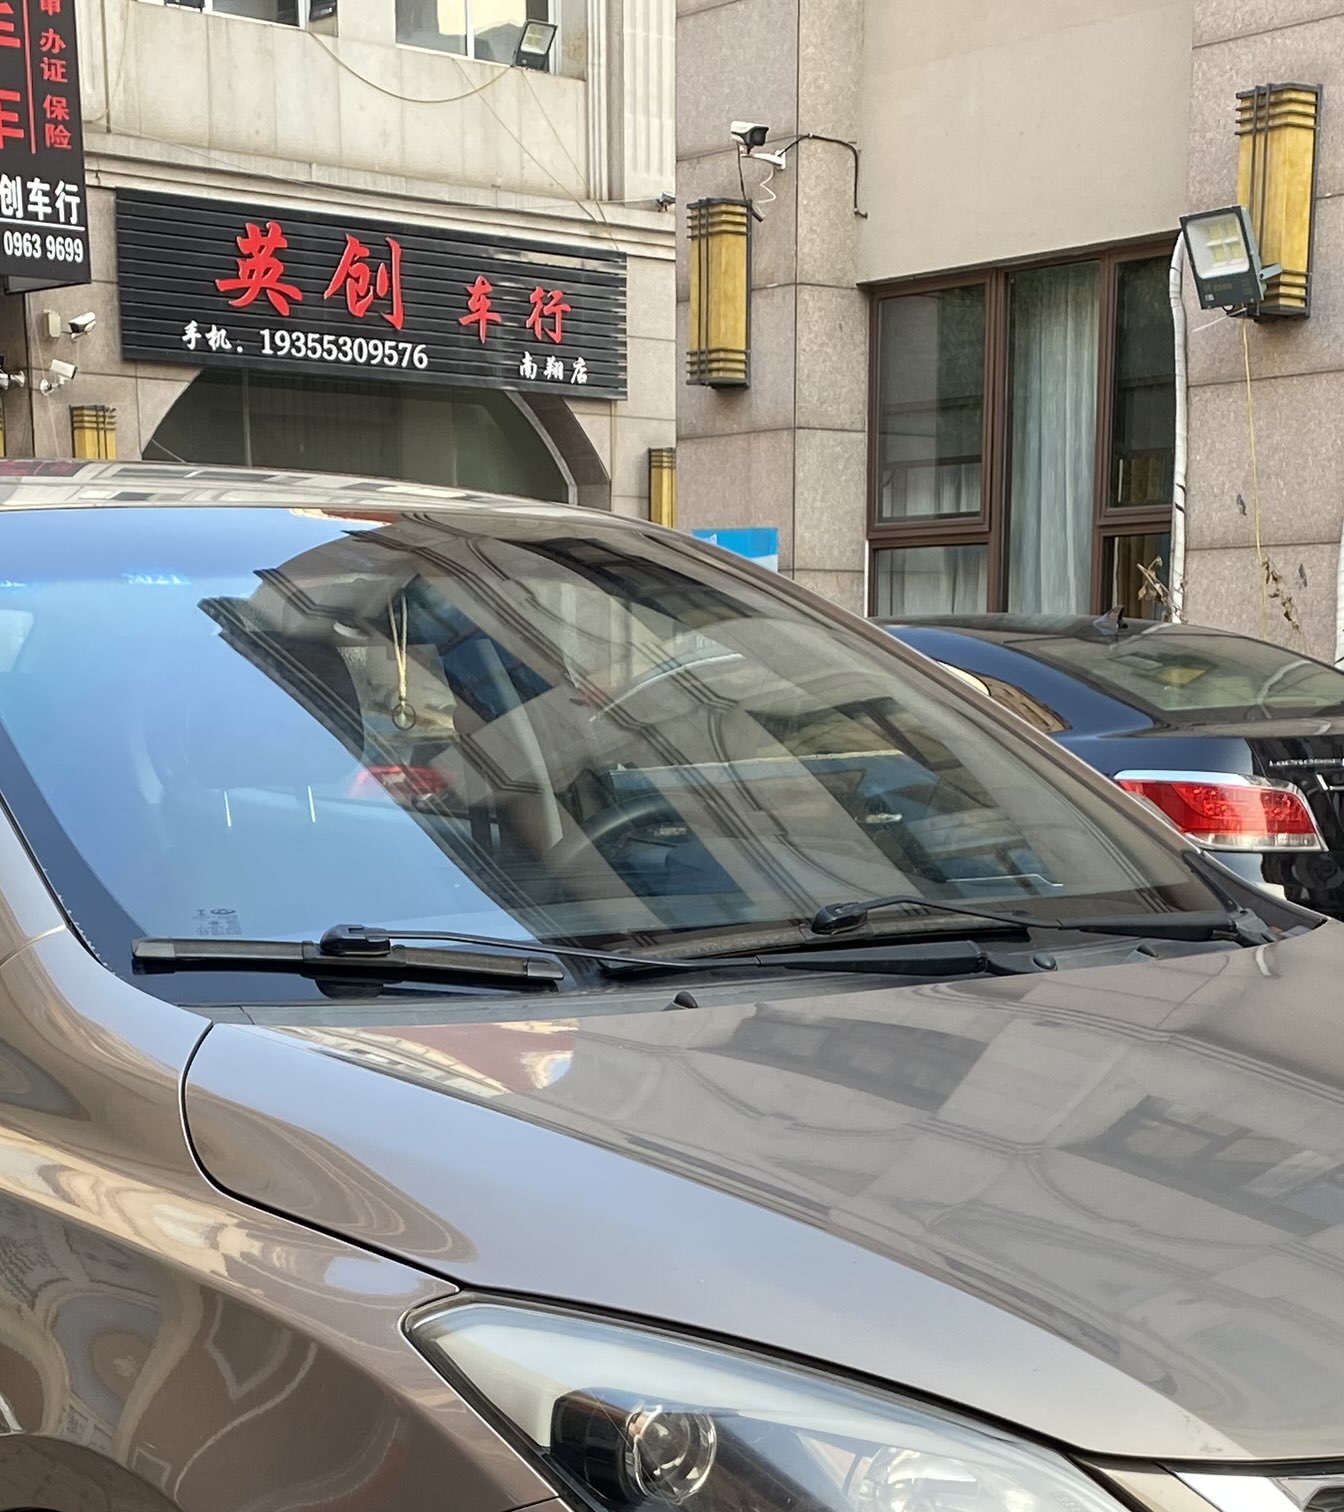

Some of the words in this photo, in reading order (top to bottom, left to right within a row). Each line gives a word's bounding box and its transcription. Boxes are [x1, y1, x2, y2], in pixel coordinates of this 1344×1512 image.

[39, 28, 68, 83] 办证
[43, 94, 72, 149] 保险
[5, 232, 41, 258] 0963
[45, 235, 83, 263] 9699
[261, 329, 429, 369] 19355309576
[519, 351, 589, 384] 南翔店
